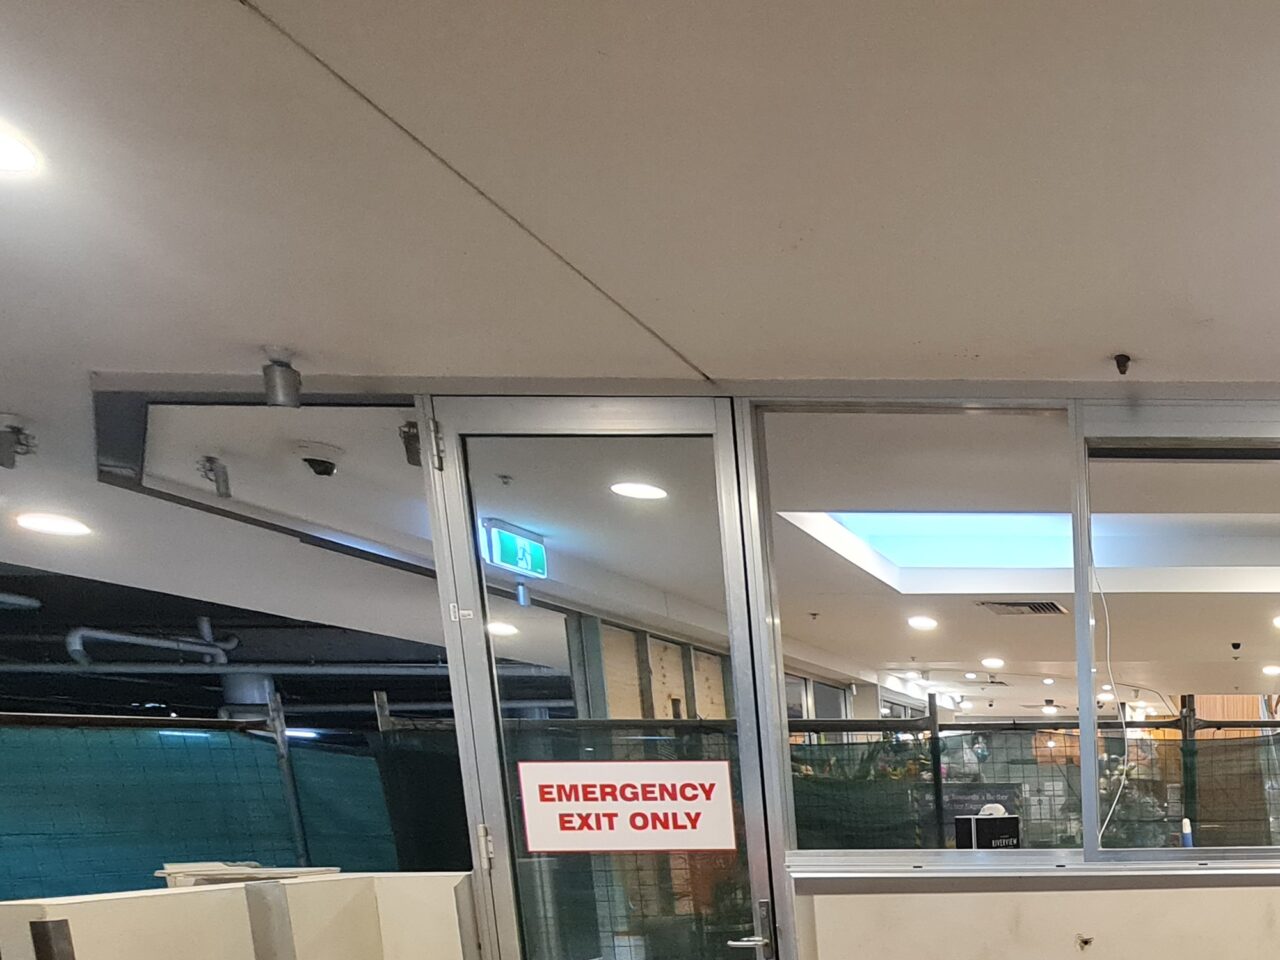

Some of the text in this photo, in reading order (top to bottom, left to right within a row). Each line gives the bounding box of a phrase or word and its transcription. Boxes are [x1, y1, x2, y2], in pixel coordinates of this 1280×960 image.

[538, 783, 716, 802] EMERGENCY
[558, 812, 702, 831] EXIT ONLY
